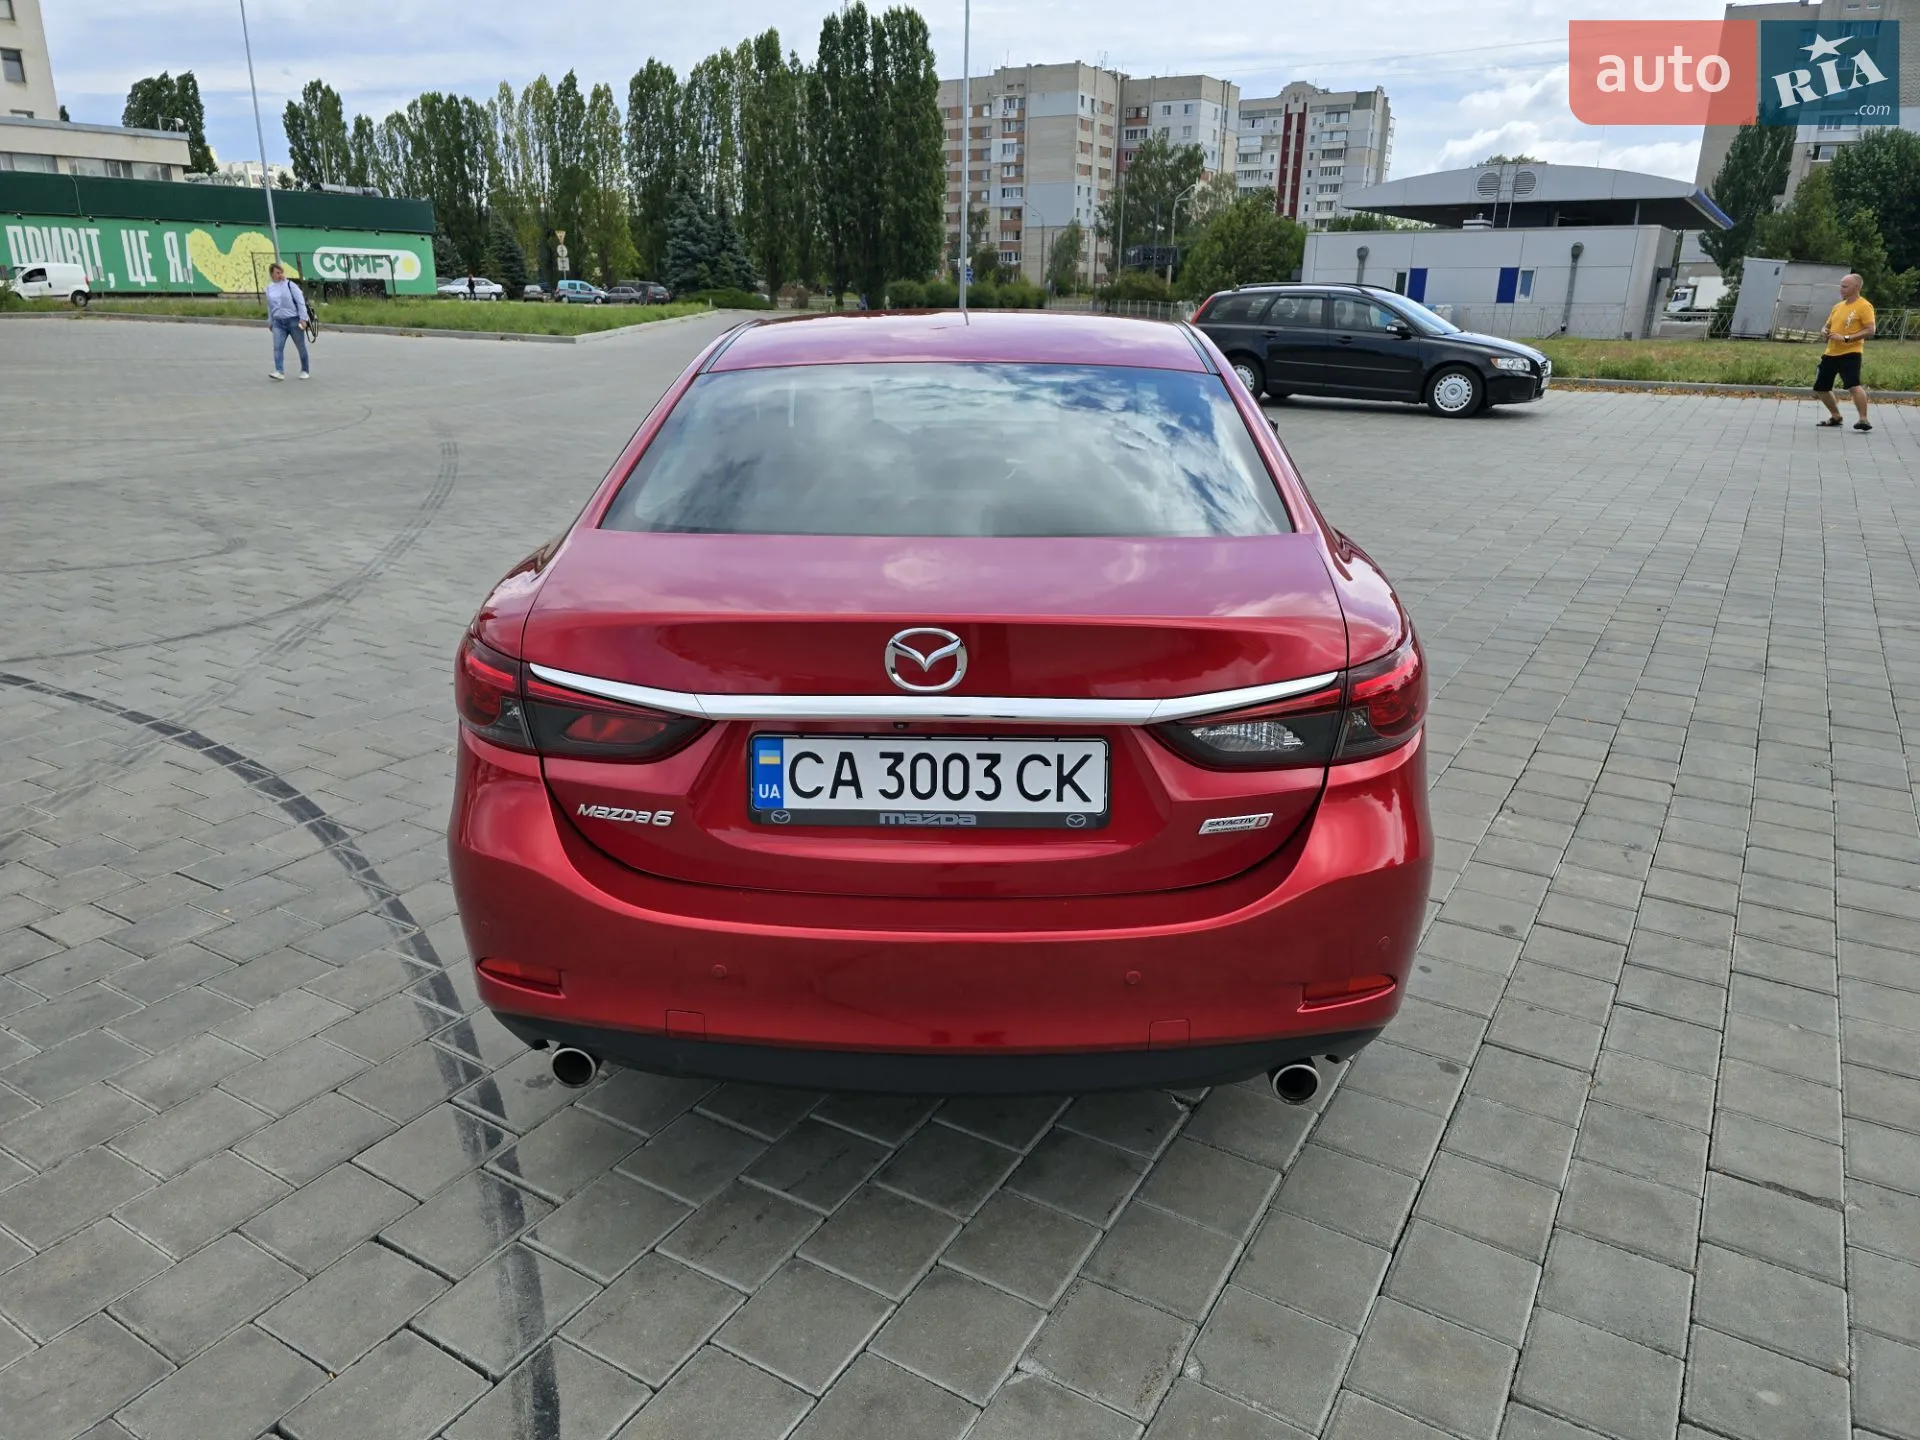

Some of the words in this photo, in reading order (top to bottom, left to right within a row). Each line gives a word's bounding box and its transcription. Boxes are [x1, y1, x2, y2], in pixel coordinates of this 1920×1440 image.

[120, 229, 158, 287] ЦЕ
[319, 252, 400, 274] COMFY
[788, 750, 864, 800] CA
[878, 751, 1002, 801] 3003
[1016, 753, 1093, 803] CK
[758, 783, 781, 799] UA
[1207, 817, 1256, 828] SKYACTIV
